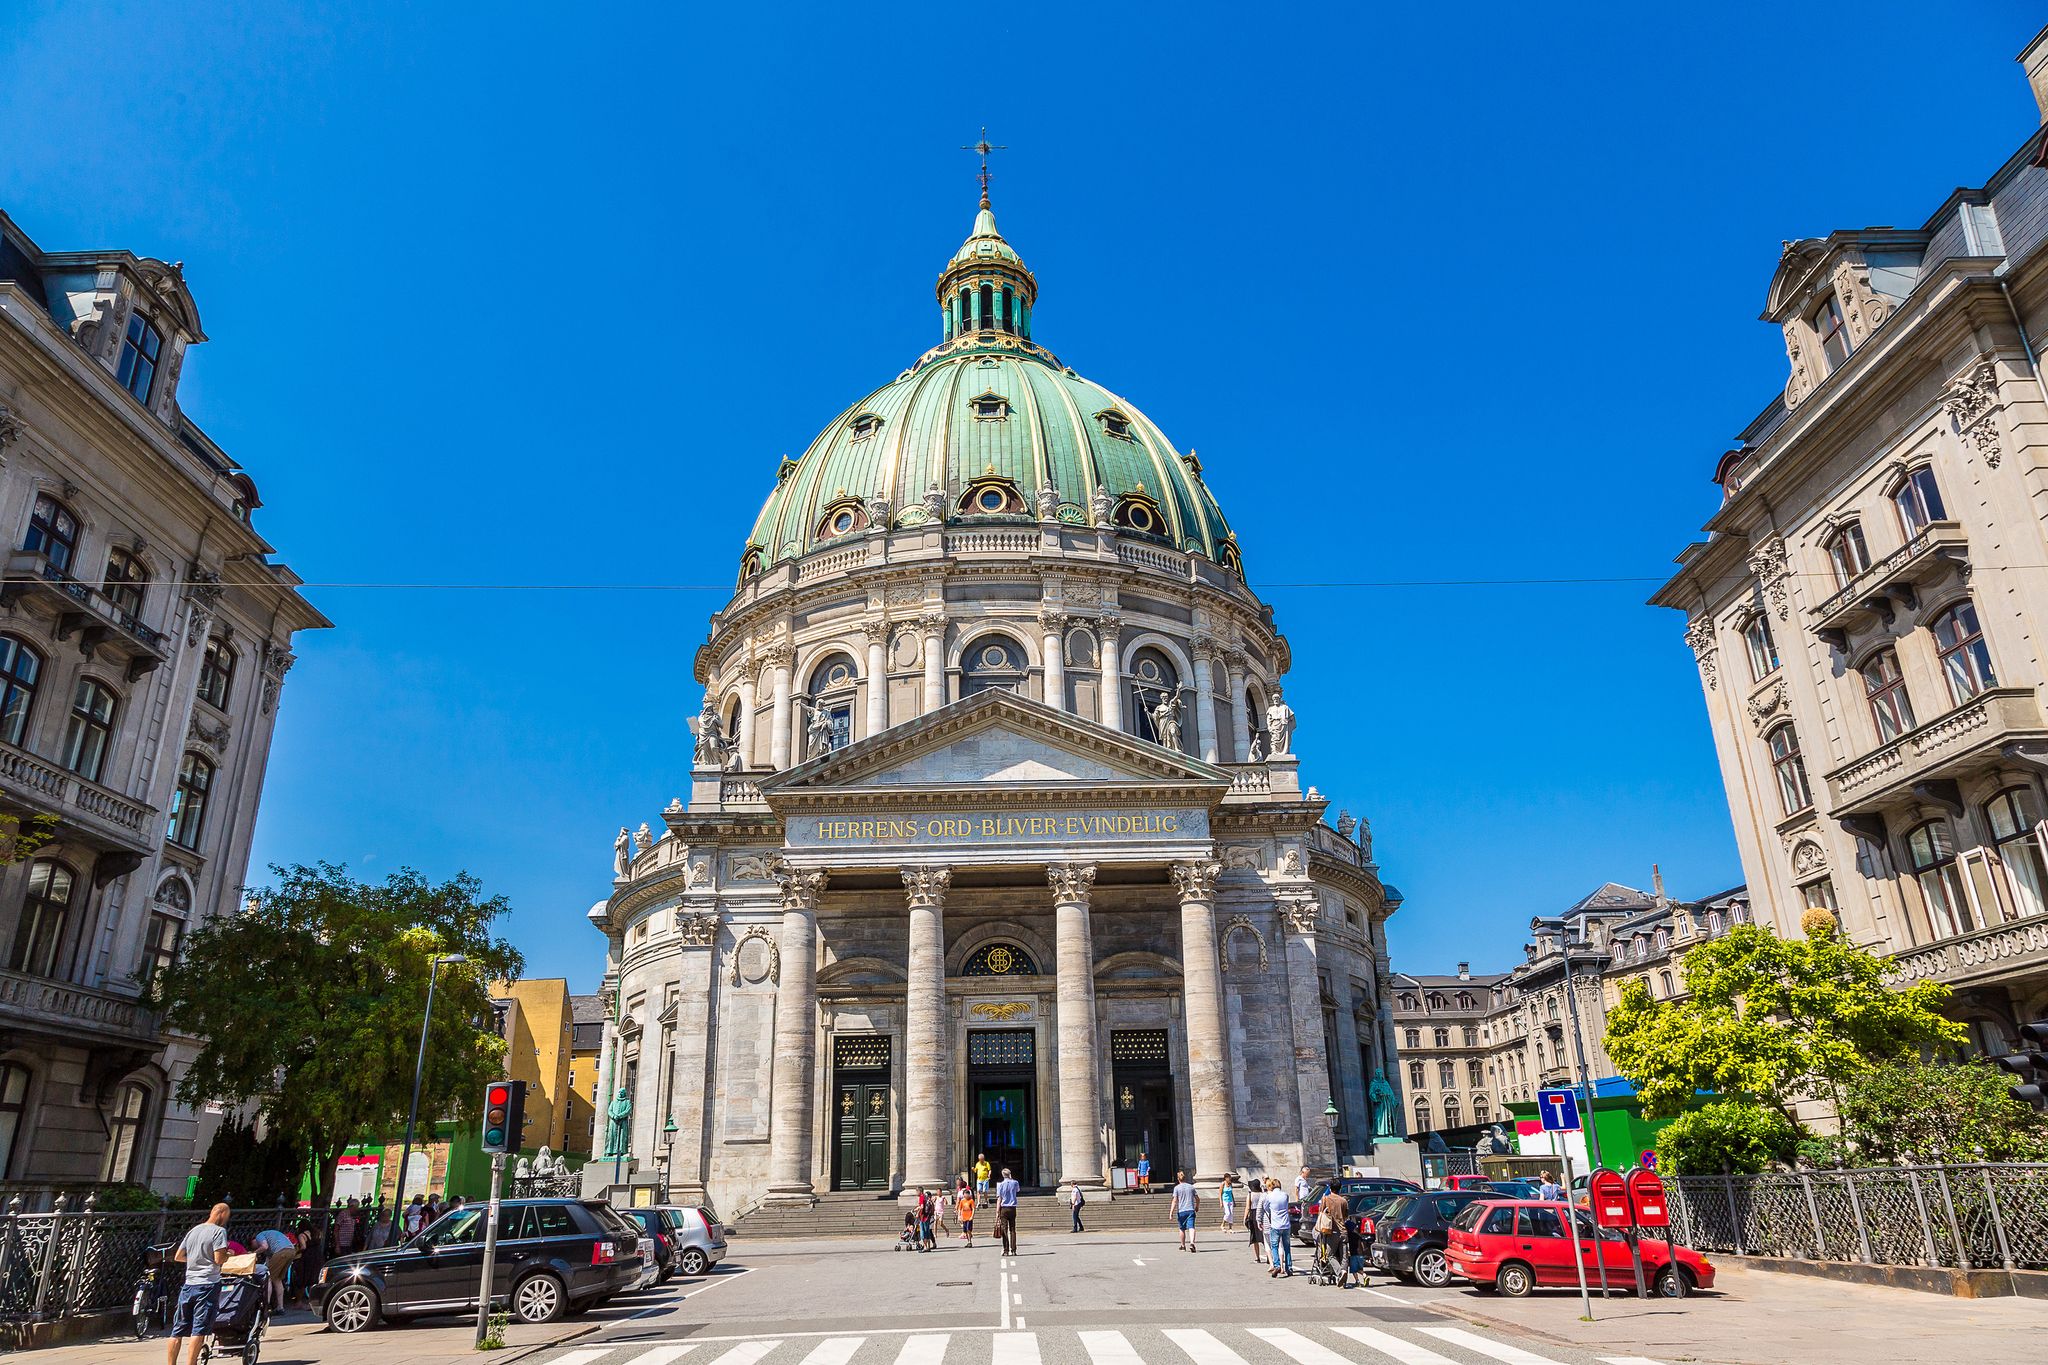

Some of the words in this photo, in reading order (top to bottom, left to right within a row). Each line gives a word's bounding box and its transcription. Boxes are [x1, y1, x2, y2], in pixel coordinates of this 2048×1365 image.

[818, 820, 918, 839] HERRENS
[927, 819, 972, 837] ORD
[981, 817, 1058, 836] BLIVER
[1066, 815, 1178, 834] EVINDELIG
